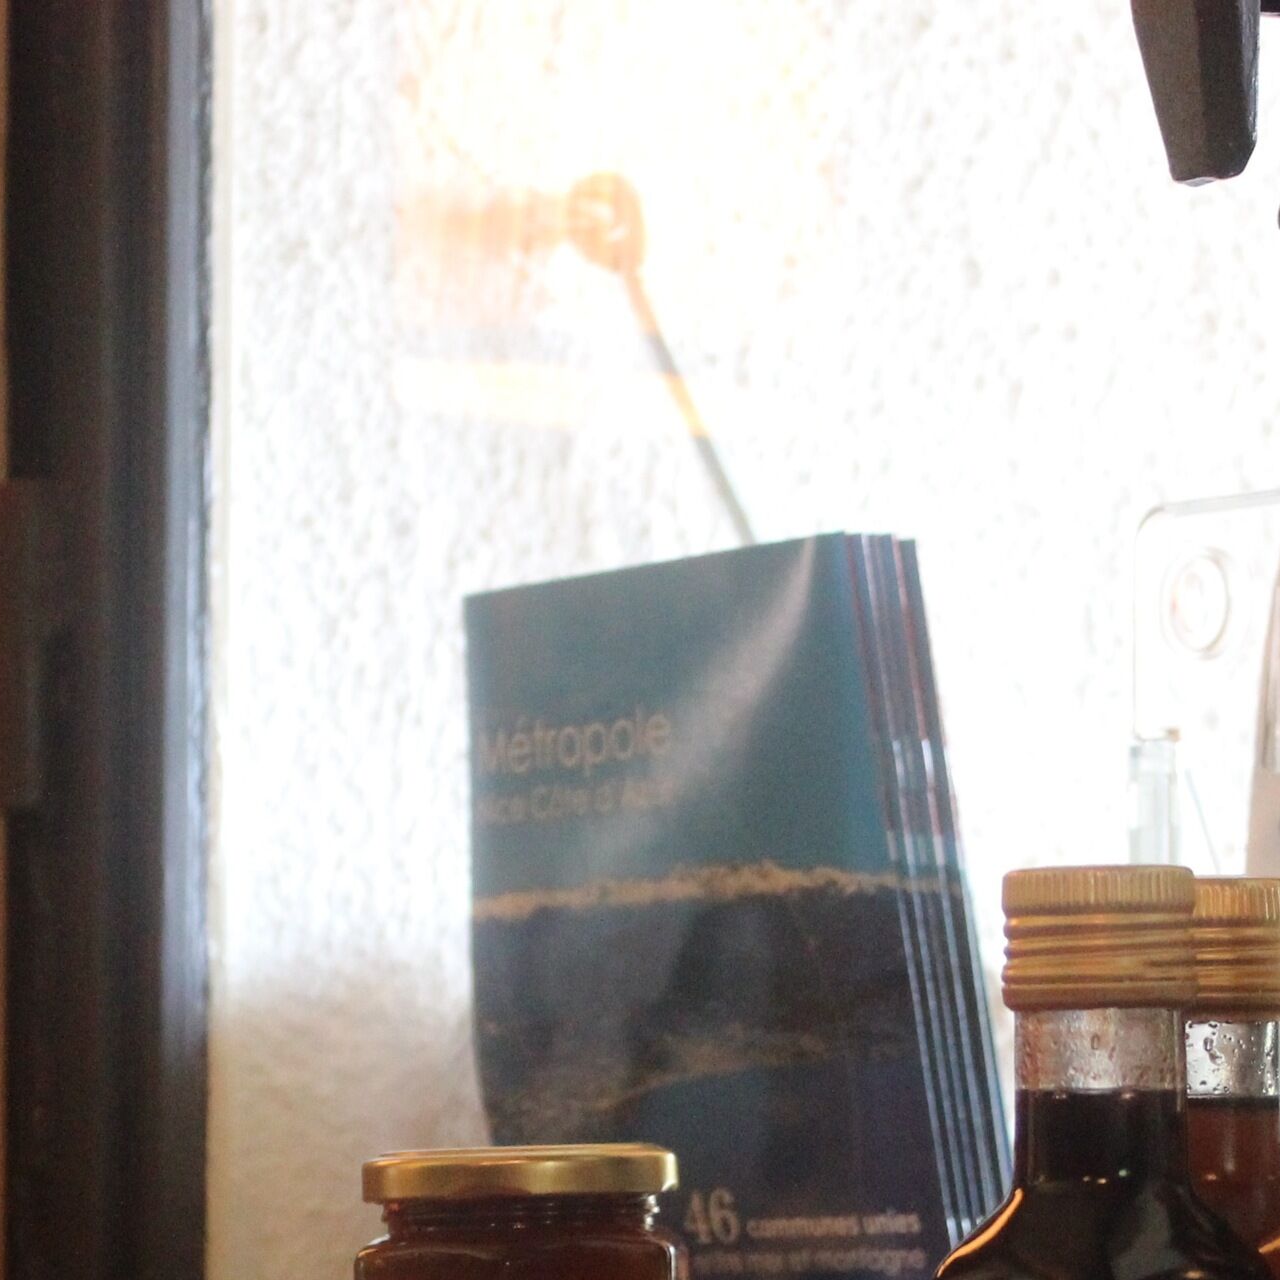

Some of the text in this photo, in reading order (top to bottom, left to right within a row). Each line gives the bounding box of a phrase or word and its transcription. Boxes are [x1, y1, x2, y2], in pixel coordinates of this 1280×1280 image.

[478, 702, 673, 780] Métropole
[684, 1187, 741, 1246] 46
[745, 1216, 860, 1239] communes
